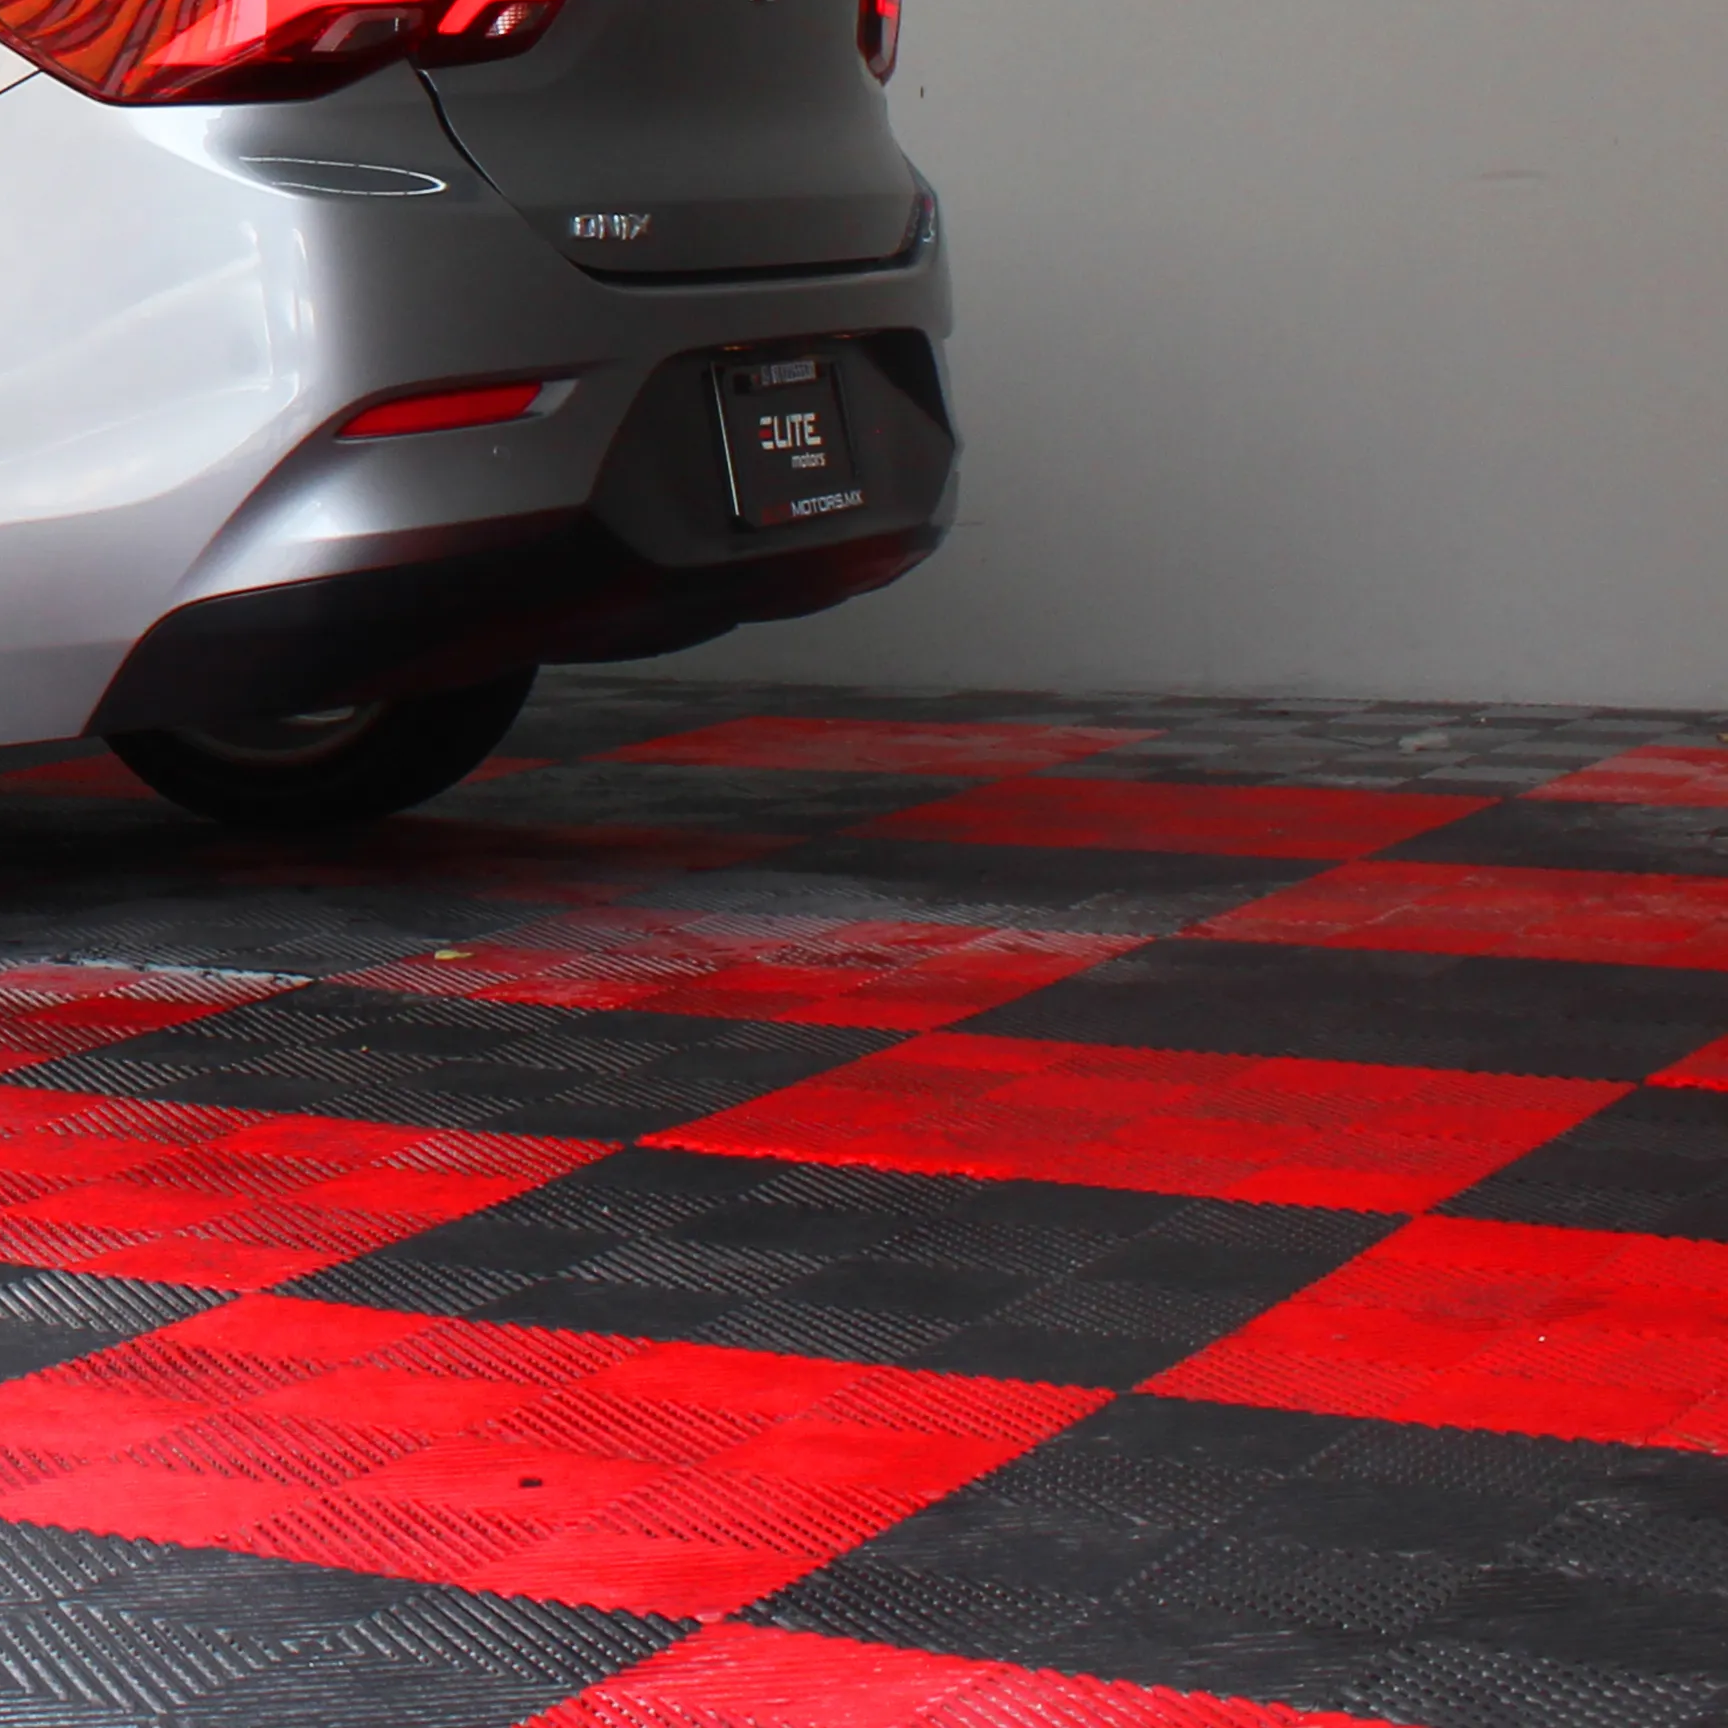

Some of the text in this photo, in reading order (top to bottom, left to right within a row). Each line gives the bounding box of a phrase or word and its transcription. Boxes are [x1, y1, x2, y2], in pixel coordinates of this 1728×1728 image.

[570, 213, 651, 240] ONIX
[759, 412, 822, 450] ELITE
[791, 452, 826, 468] motors
